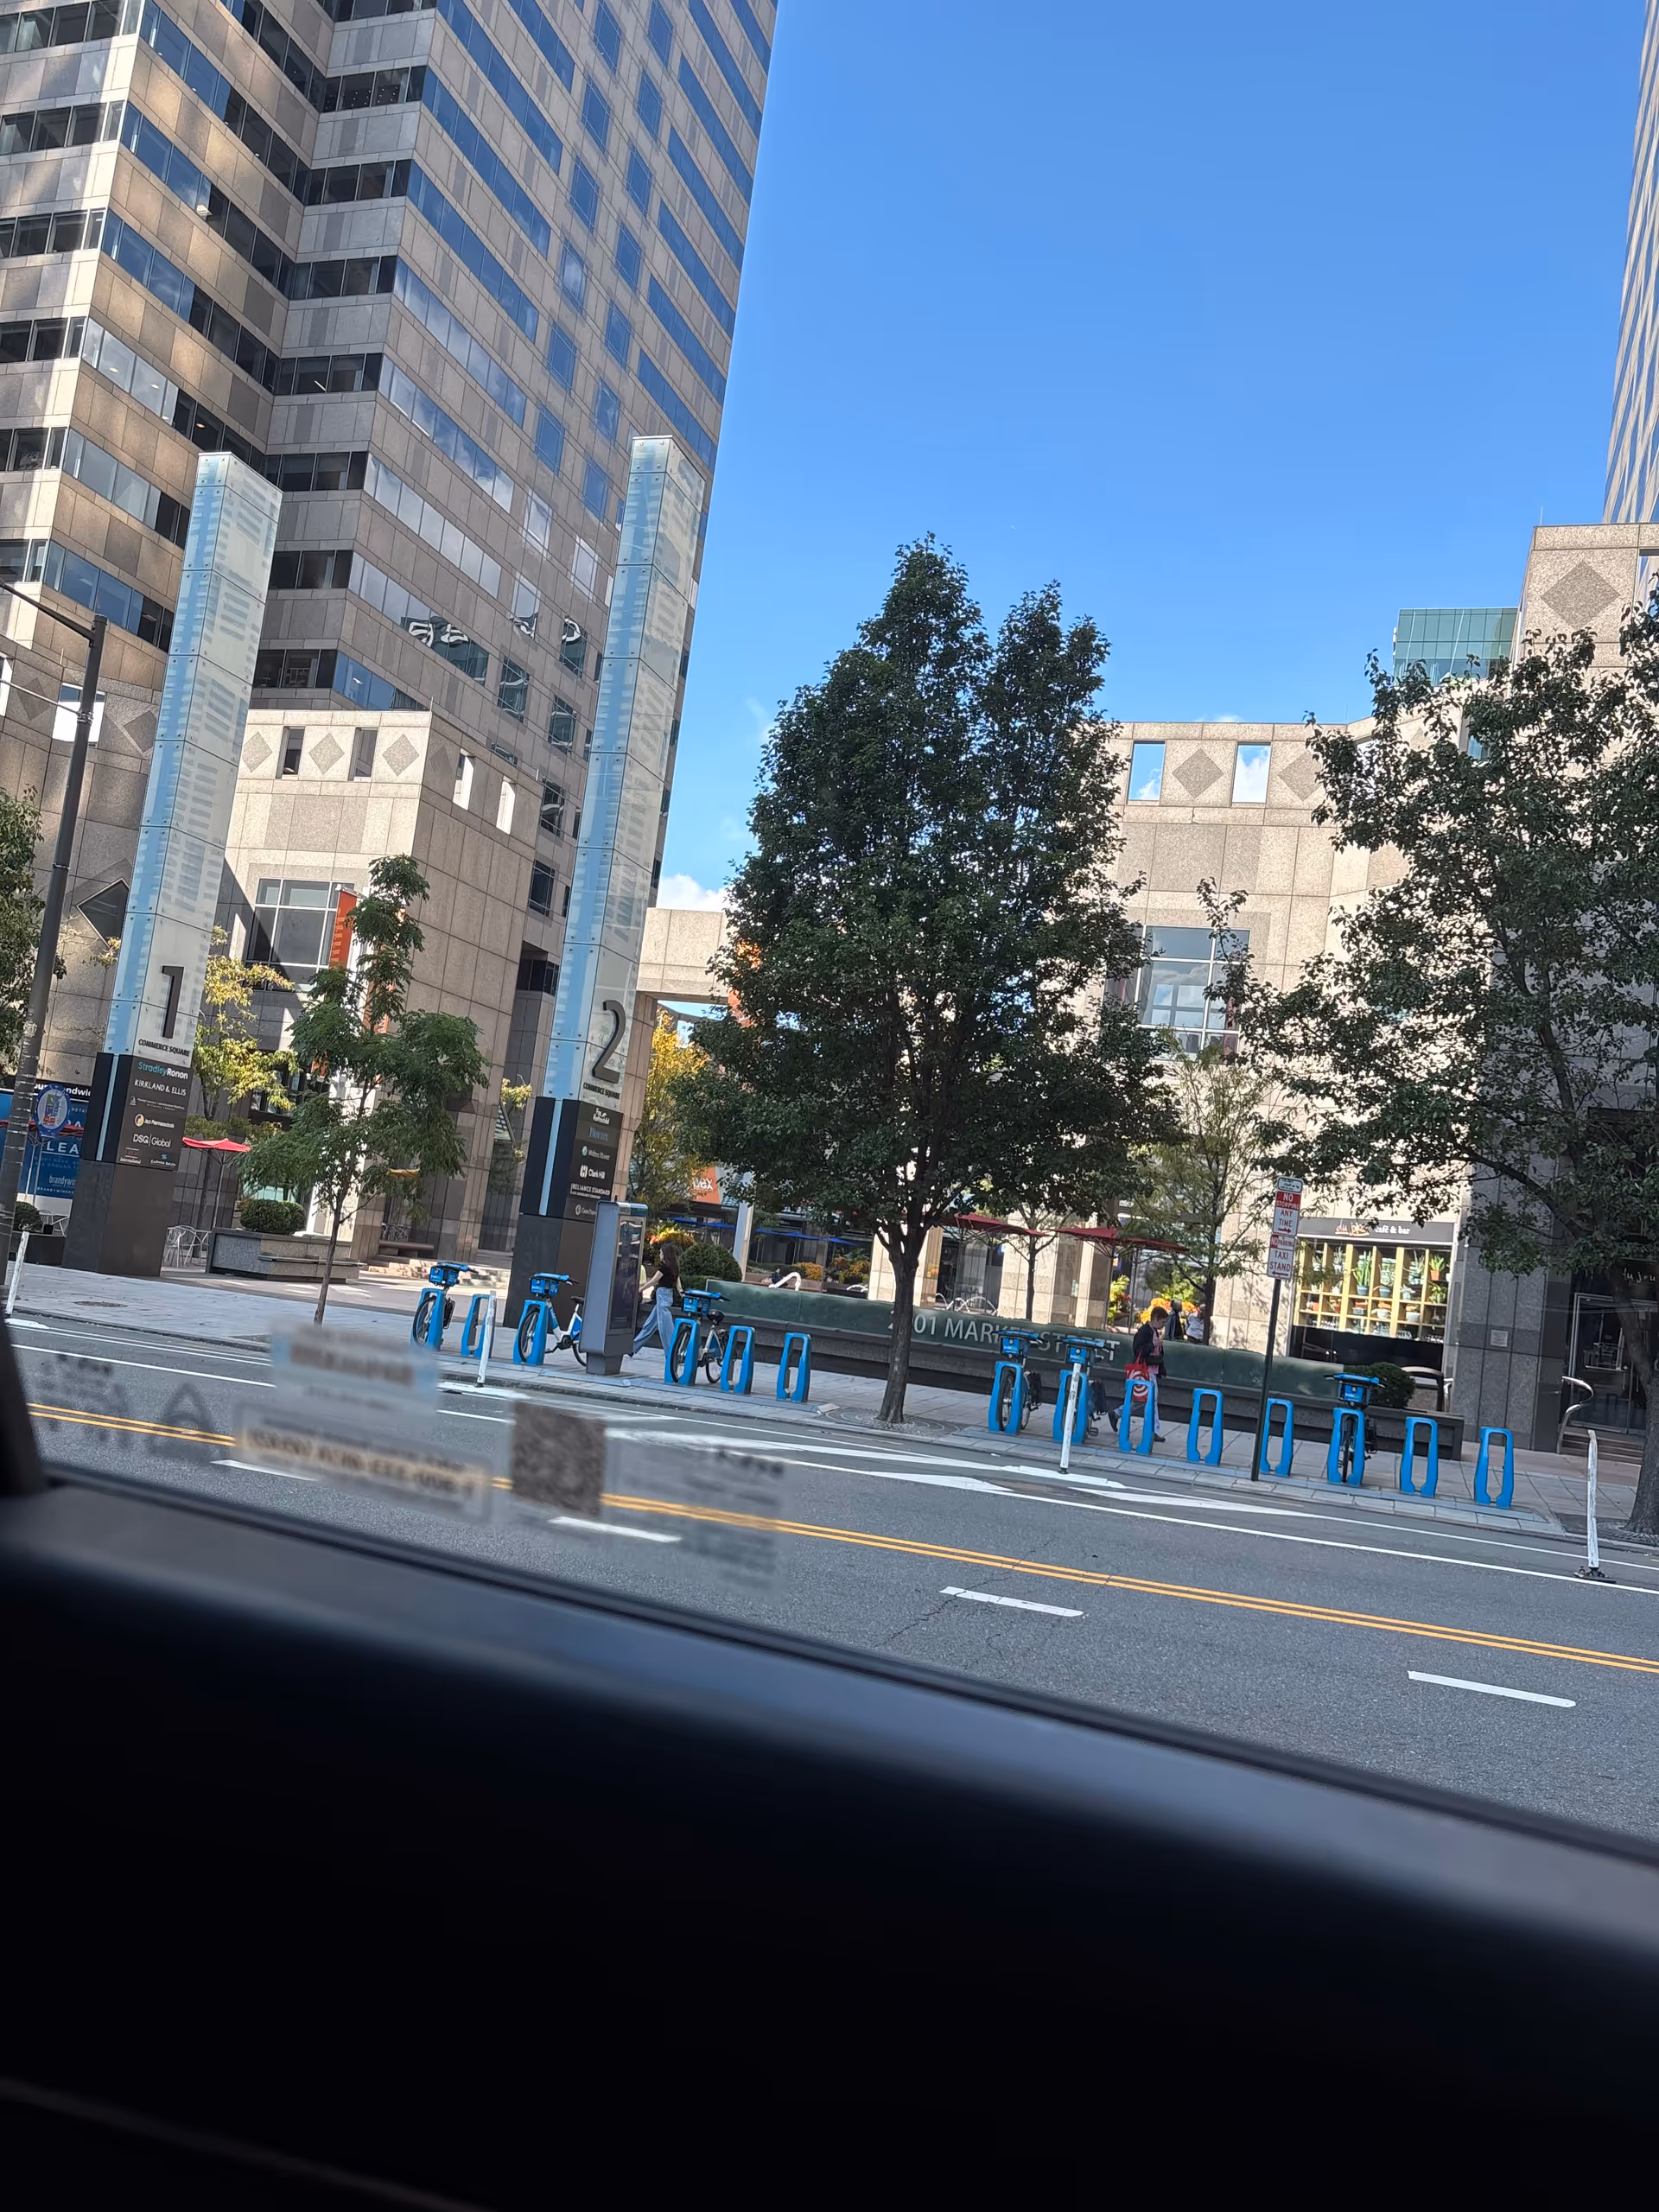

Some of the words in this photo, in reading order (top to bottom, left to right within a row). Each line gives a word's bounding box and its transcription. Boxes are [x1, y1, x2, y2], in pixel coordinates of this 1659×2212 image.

[162, 965, 184, 1039] 1
[138, 1039, 168, 1052] COMMERCE
[168, 1046, 190, 1057] SQUARE
[592, 1000, 626, 1084] 2
[134, 1078, 164, 1091] KIRKLAND
[171, 1086, 187, 1096] ELLIS
[583, 1082, 605, 1095] COMMERCE
[605, 1089, 620, 1100] SQUARE
[46, 1141, 79, 1155] LEA
[1283, 1192, 1294, 1203] NO
[1276, 1200, 1300, 1210] STOPPING
[1279, 1218, 1293, 1228] TIME
[1389, 1225, 1397, 1234] &
[1270, 1236, 1279, 1245] NO
[1274, 1249, 1288, 1260] TAXI
[1269, 1261, 1291, 1272] STAND
[944, 1317, 1034, 1344] MARK
